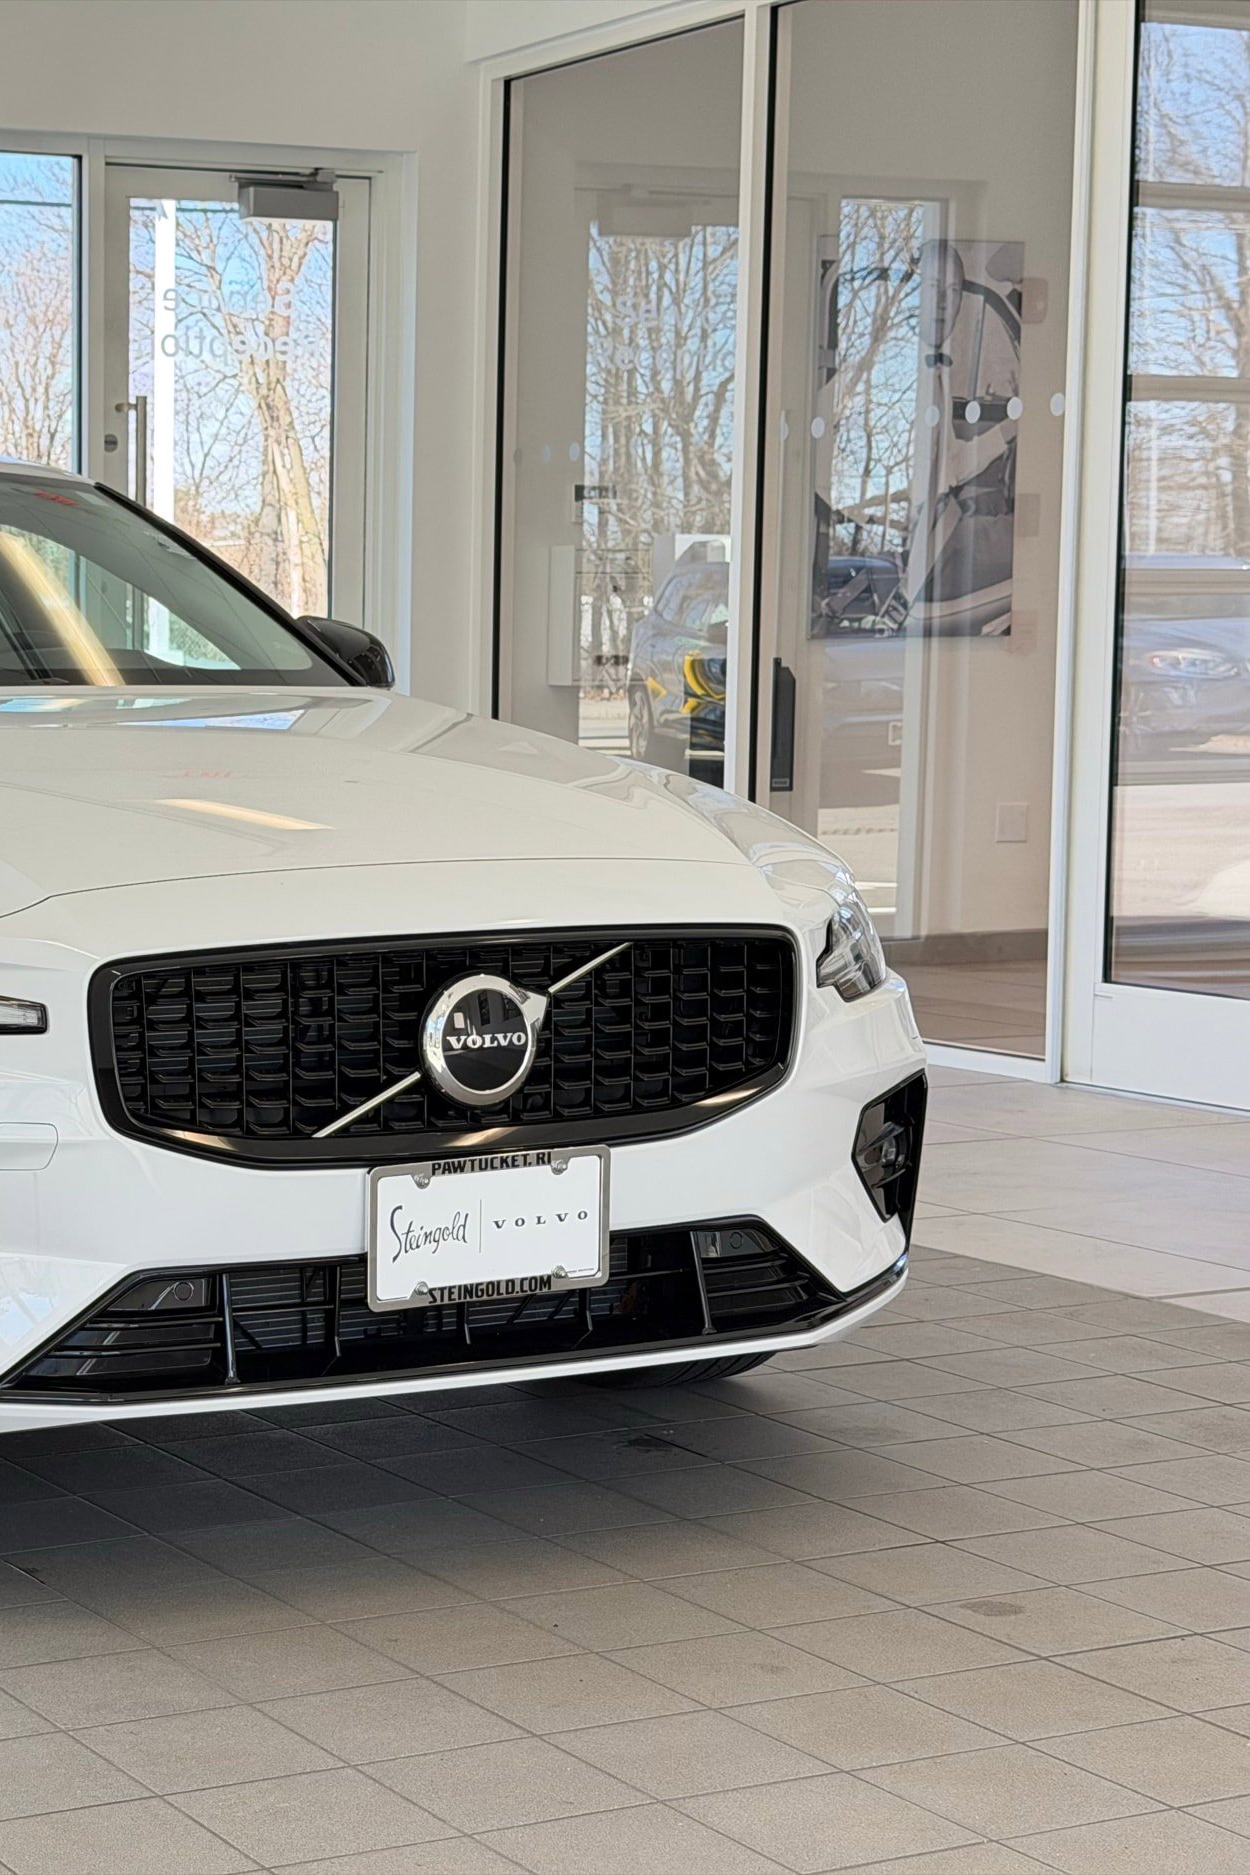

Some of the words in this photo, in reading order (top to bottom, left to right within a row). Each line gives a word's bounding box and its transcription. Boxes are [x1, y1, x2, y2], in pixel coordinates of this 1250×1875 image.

[446, 1031, 526, 1050] VOLVO
[536, 1151, 551, 1166] RI
[389, 1205, 469, 1263] Steingold
[493, 1210, 589, 1230] VOLVO
[428, 1275, 552, 1305] STEINGOLD.COM
